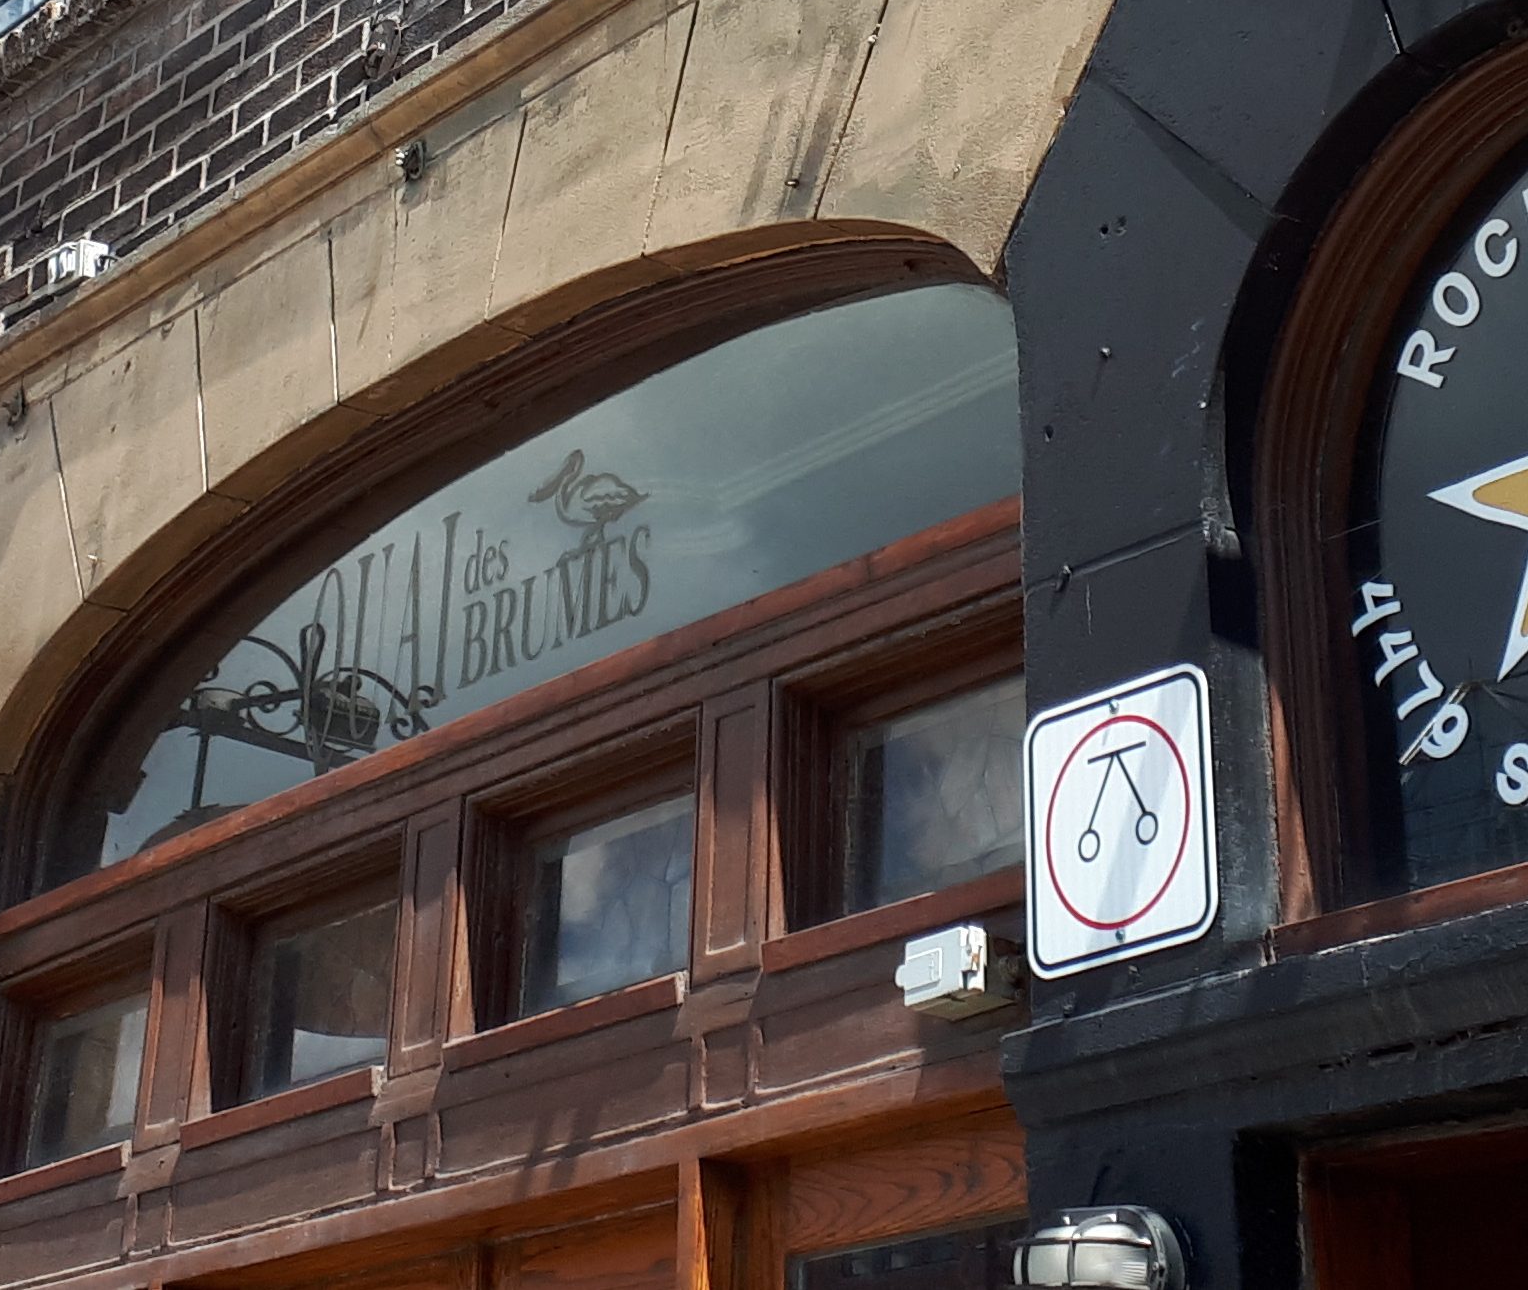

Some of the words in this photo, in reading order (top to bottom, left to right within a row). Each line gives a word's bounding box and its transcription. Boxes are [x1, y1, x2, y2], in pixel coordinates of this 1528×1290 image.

[303, 511, 461, 776] QUAI
[458, 525, 651, 689] BRUMES
[464, 530, 509, 595] des
[1352, 582, 1469, 759] 4479
